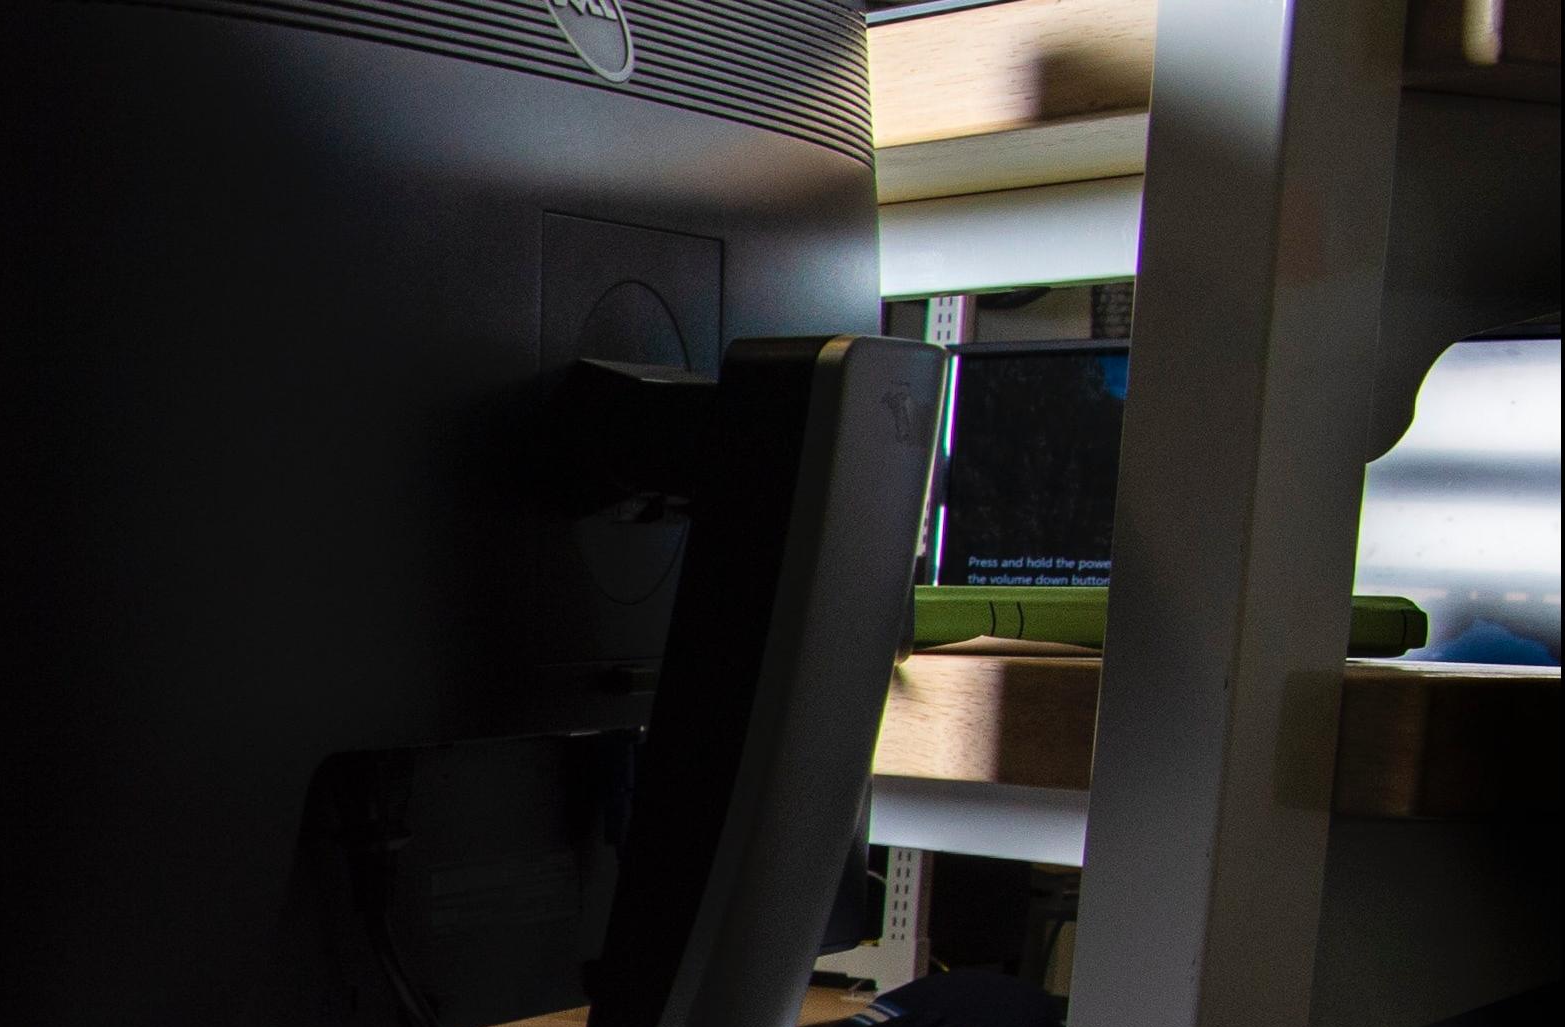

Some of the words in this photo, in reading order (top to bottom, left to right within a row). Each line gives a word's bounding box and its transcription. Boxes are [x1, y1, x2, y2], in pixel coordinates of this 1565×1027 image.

[968, 556, 999, 568] Press
[1001, 556, 1024, 568] and
[1026, 556, 1053, 568] hold
[1055, 556, 1076, 568] the
[1078, 559, 1112, 571] powe
[968, 574, 988, 585] the
[990, 574, 1033, 585] volume
[1035, 574, 1069, 585] down
